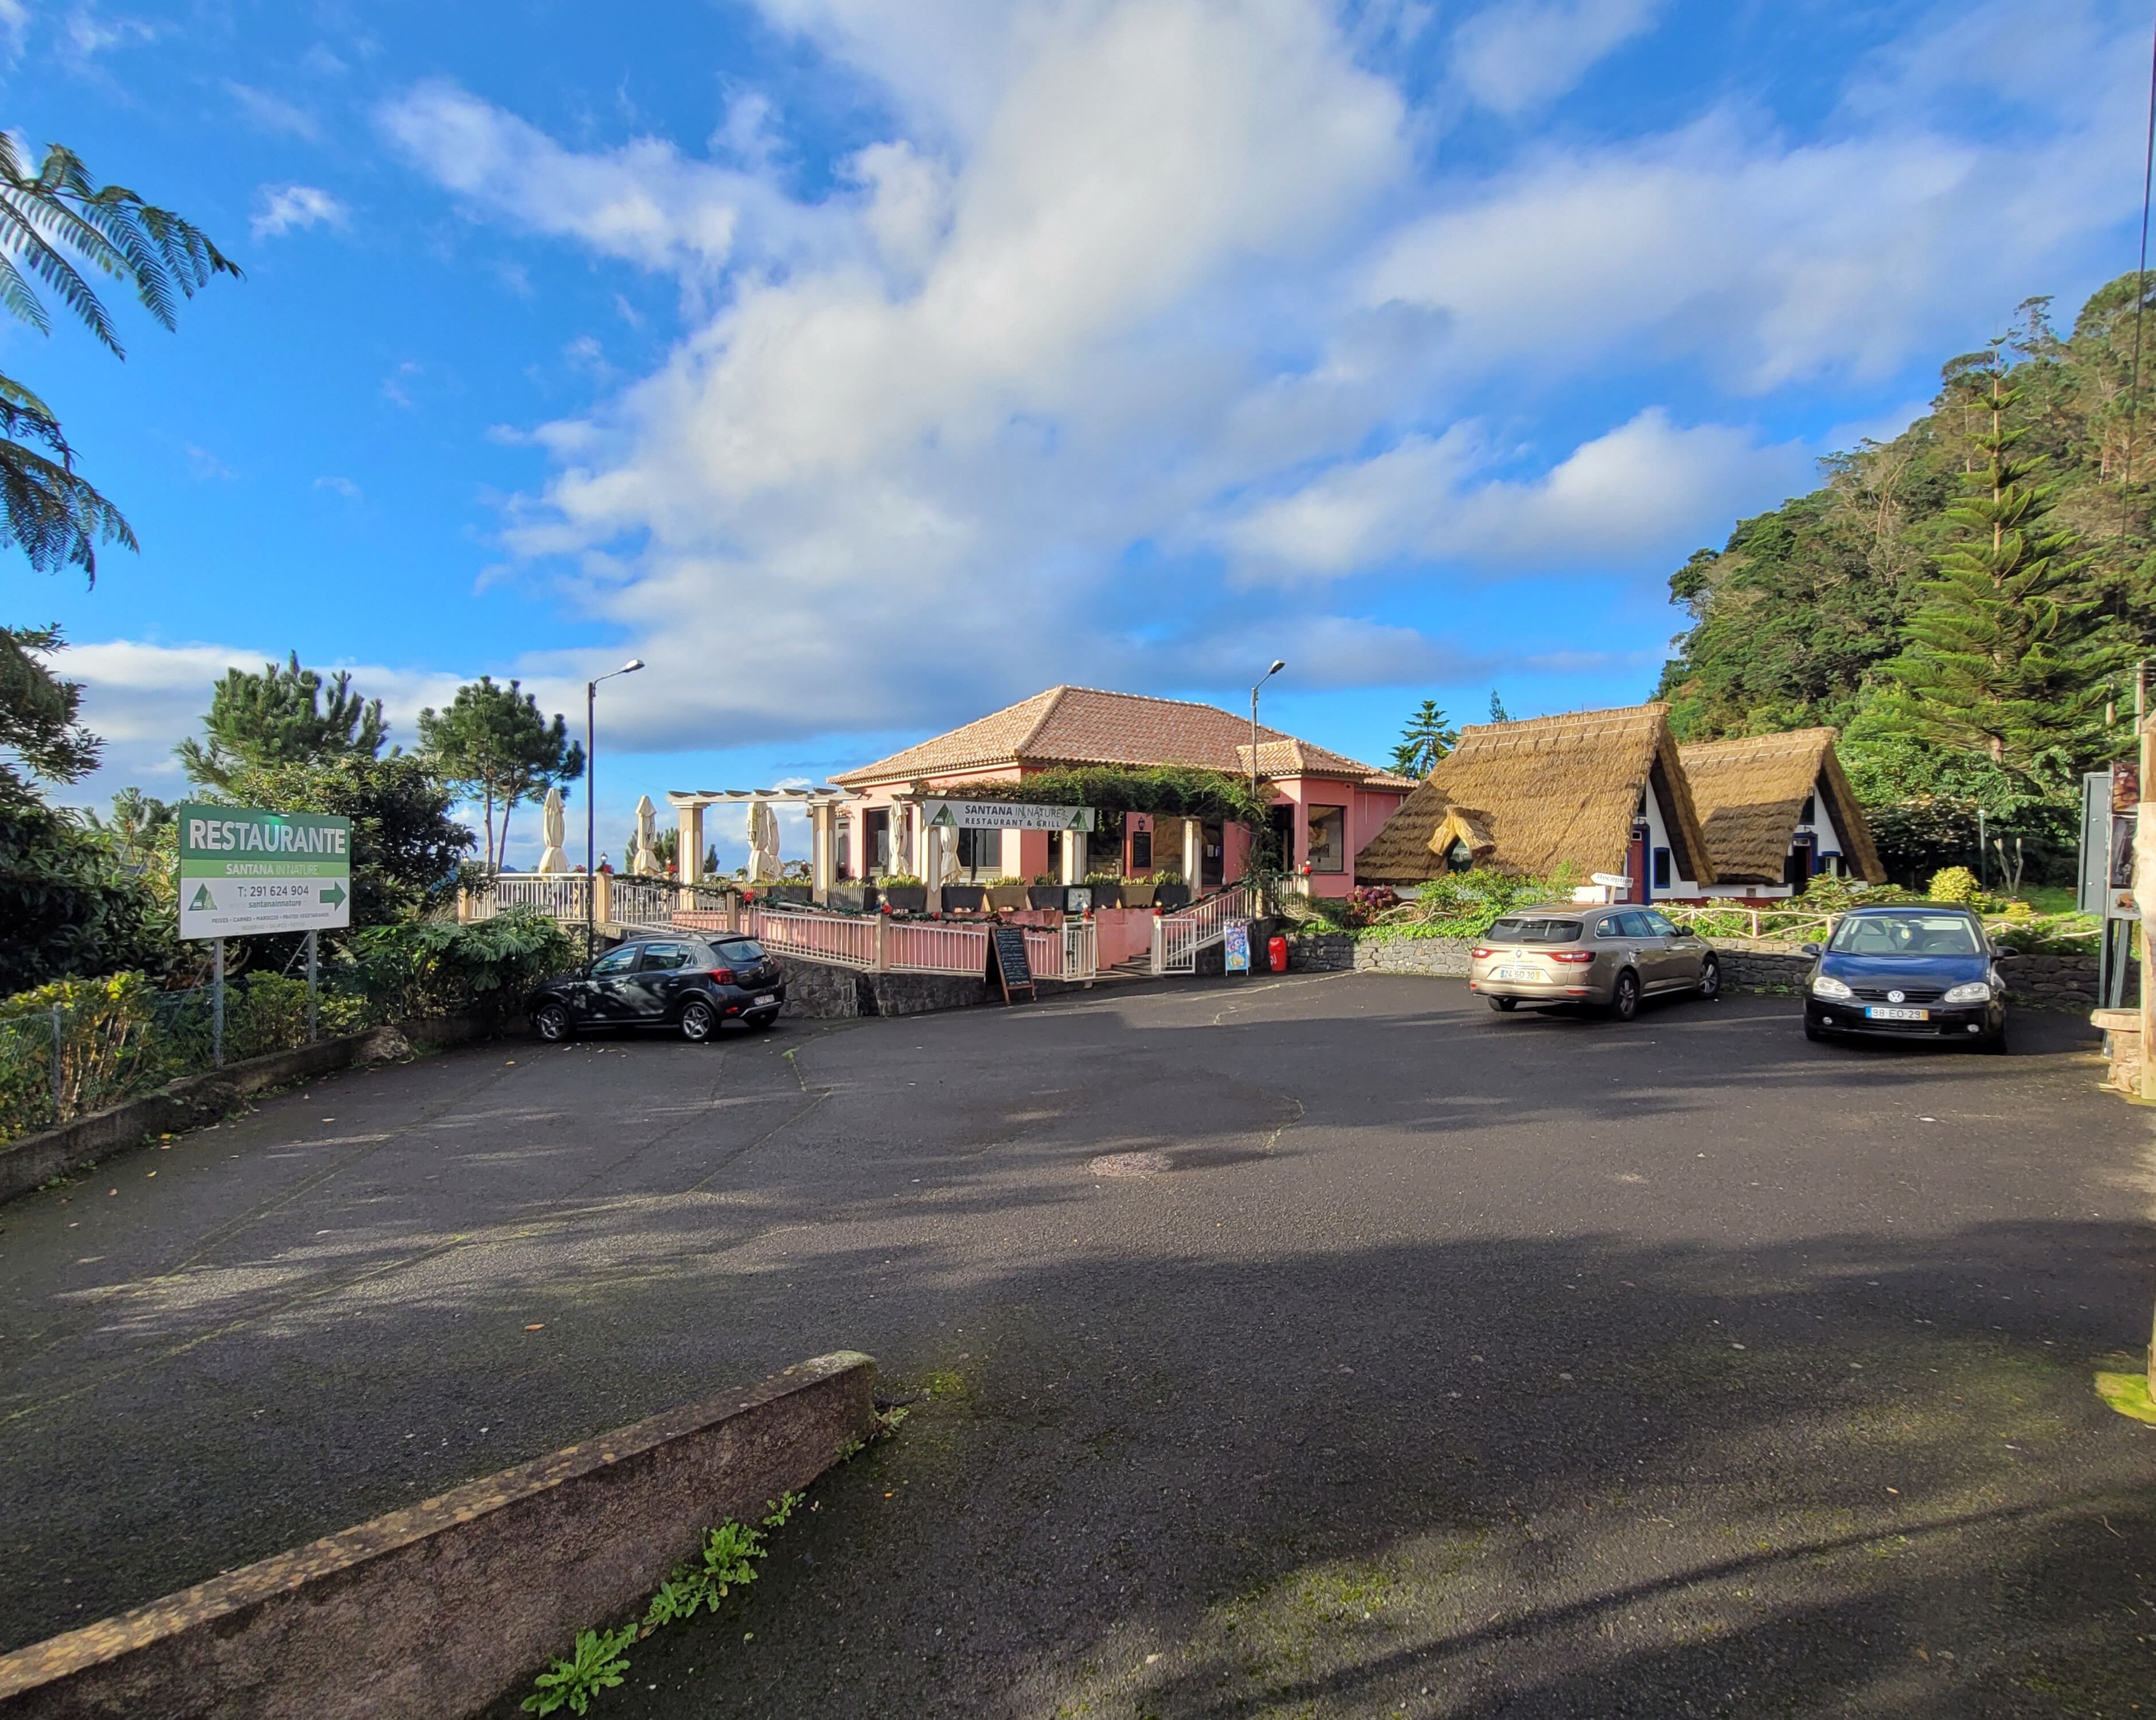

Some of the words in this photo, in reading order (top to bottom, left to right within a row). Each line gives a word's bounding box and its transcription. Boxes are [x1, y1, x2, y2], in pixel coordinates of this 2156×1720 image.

[964, 804, 1013, 815] SANTANA
[1027, 807, 1063, 818] NATURE
[965, 817, 1023, 826] RESTAURANT
[1036, 820, 1060, 828] GRILL
[189, 819, 346, 854] RESTAURANTE
[226, 863, 274, 875] SANTANA
[276, 865, 286, 874] IN
[287, 865, 319, 875] NATURE
[1597, 874, 1632, 884] Reception
[237, 886, 247, 897] T:
[250, 886, 267, 897] 291
[270, 886, 288, 896] 624
[291, 885, 309, 896] 904
